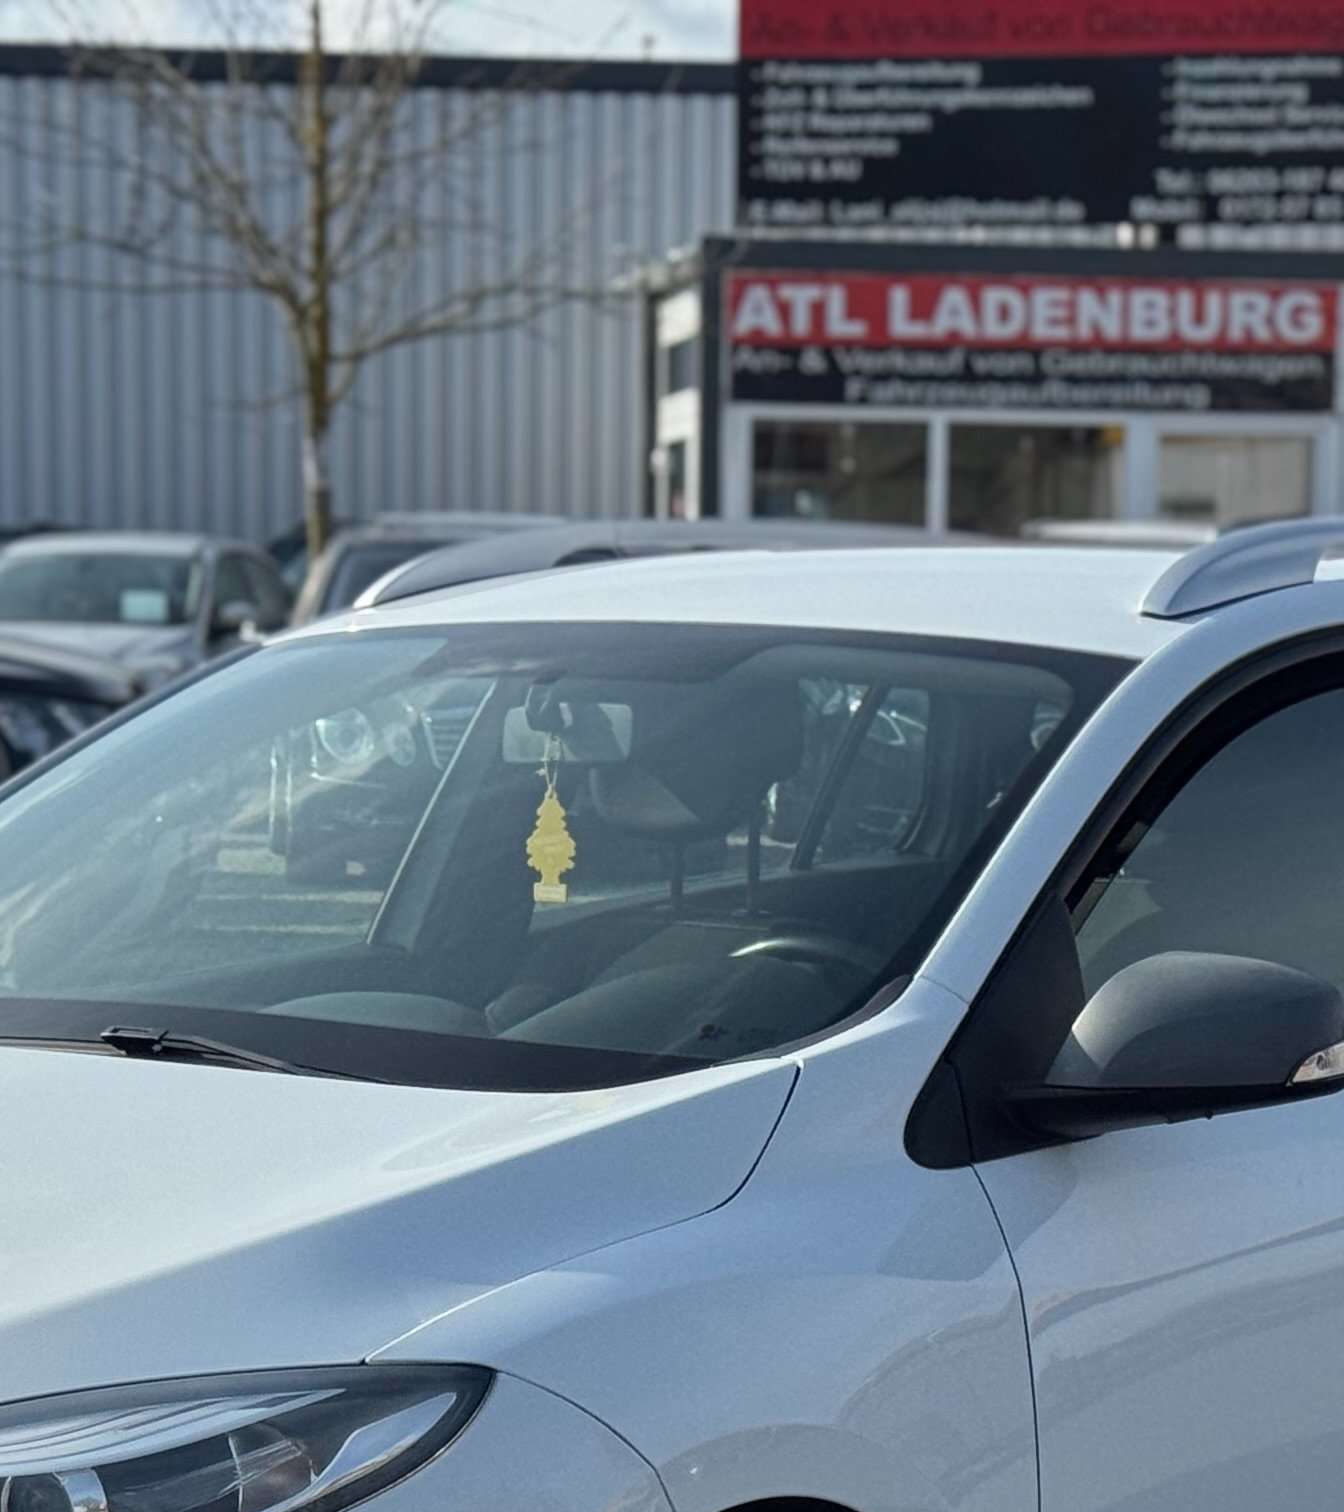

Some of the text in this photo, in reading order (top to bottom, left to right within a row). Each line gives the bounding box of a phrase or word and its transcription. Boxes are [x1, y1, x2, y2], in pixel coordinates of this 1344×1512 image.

[733, 284, 1325, 343] ATL LADENBURG
[799, 347, 828, 376] &
[831, 347, 966, 377] Verkauf
[970, 354, 1035, 376] von
[1038, 349, 1326, 386] Gebrauchtwagen
[844, 375, 1211, 409] Fahrzeugaufbereitung
